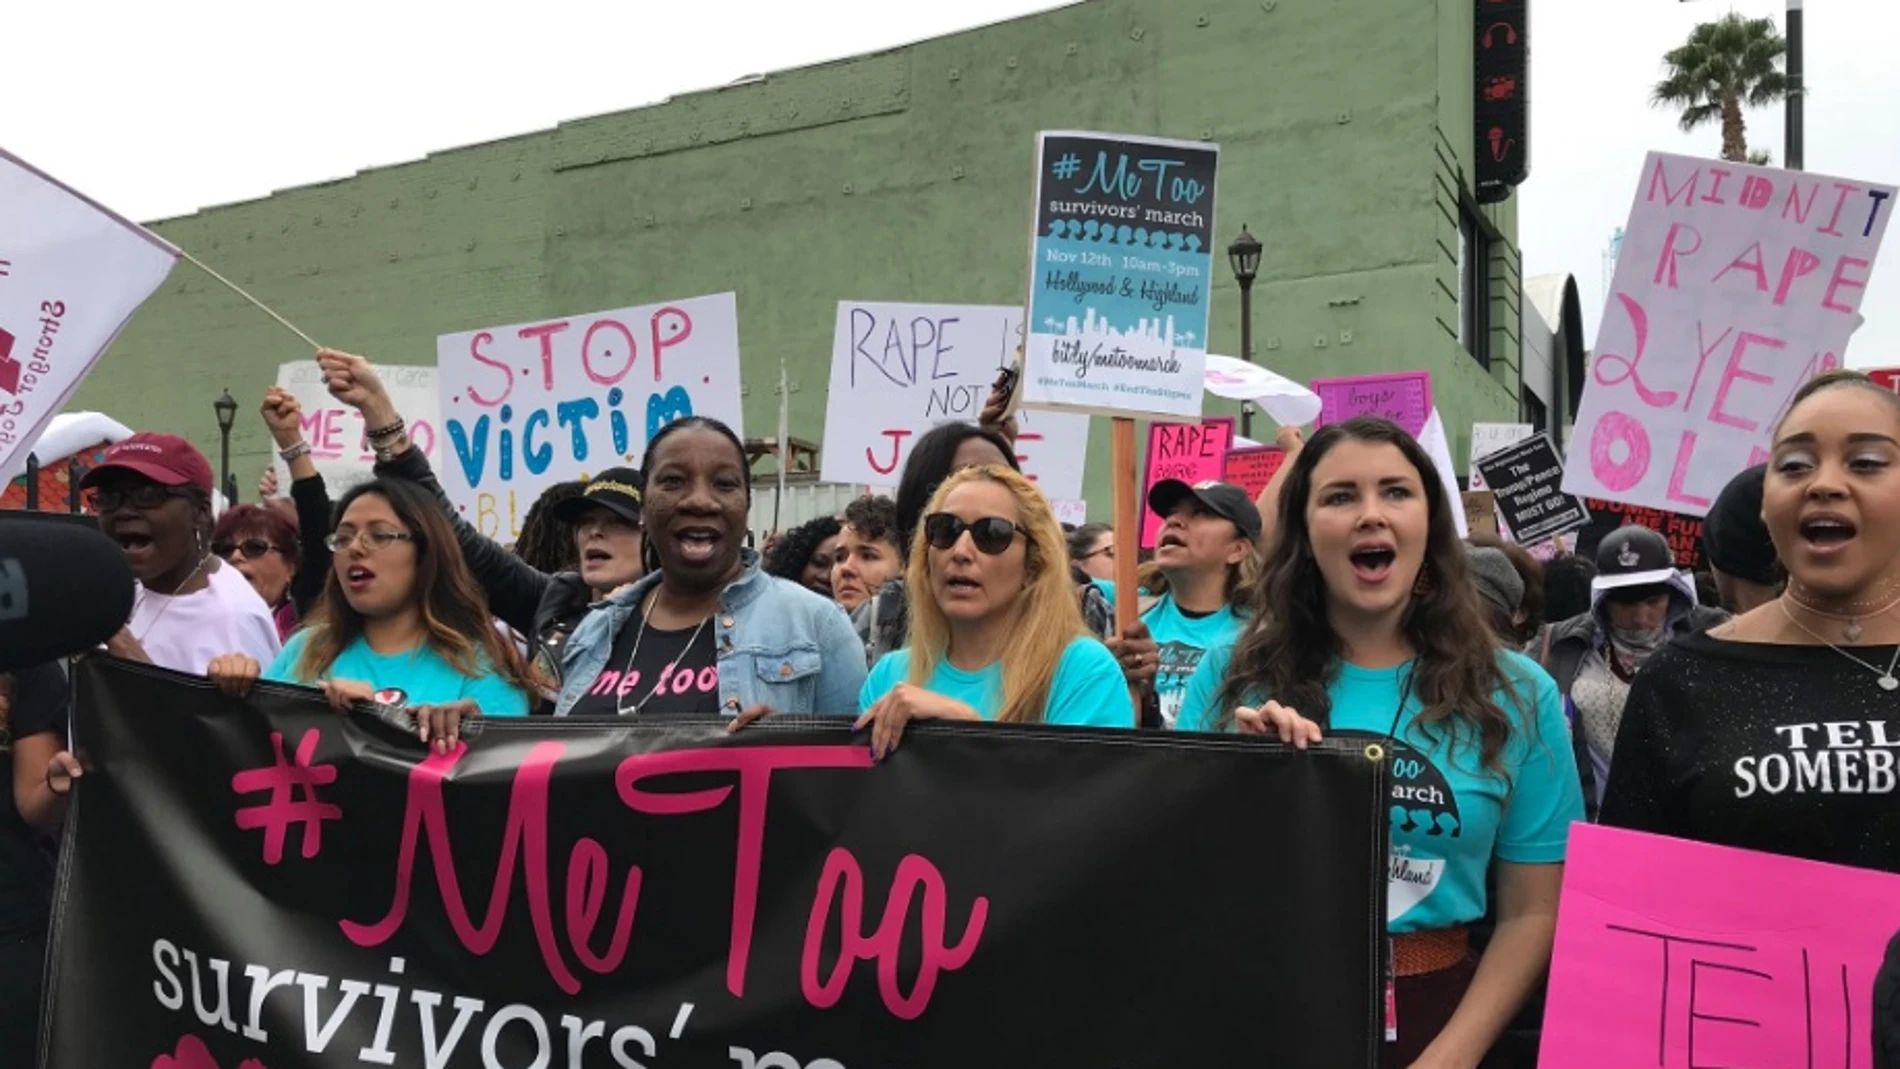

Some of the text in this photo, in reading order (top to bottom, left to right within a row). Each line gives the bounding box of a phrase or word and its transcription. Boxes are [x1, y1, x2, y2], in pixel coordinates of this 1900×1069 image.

[1050, 199, 1204, 228] survivors' march
[1046, 249, 1201, 277] Nov 12th 10am-3pm
[1653, 221, 1869, 315] RAPE
[1119, 276, 1134, 297] &
[468, 307, 693, 407] STOP
[850, 308, 960, 388] RAPE
[926, 384, 985, 418] NOT
[1159, 425, 1218, 460] RAPE
[1508, 463, 1531, 477] The
[1515, 503, 1545, 523] MUST
[655, 660, 719, 696] too
[1734, 750, 1900, 798] SOMEB
[1391, 784, 1445, 805] arch
[152, 938, 695, 1069] survivors'
